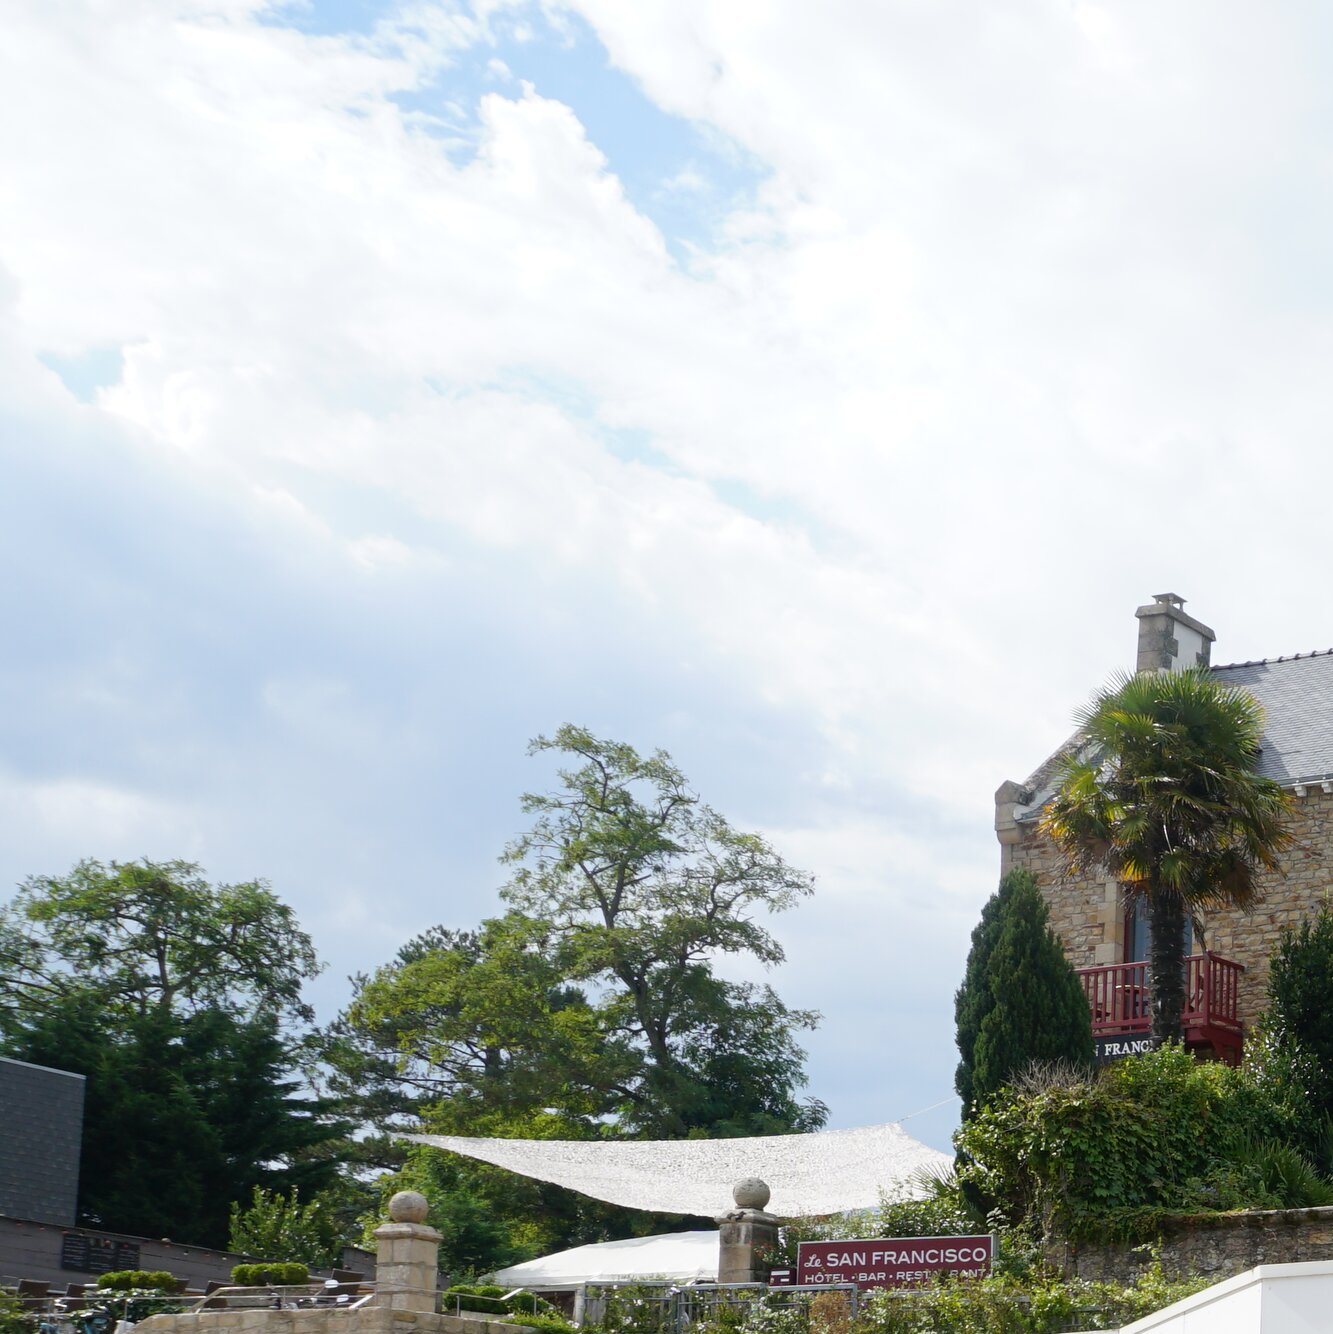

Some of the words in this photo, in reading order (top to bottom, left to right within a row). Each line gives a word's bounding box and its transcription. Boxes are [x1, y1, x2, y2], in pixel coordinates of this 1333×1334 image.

[803, 1253, 822, 1268] Le
[826, 1252, 867, 1267] SAN
[871, 1247, 987, 1266] FRANCISCO
[804, 1271, 849, 1284] HÔTEL
[858, 1272, 886, 1282] BAR
